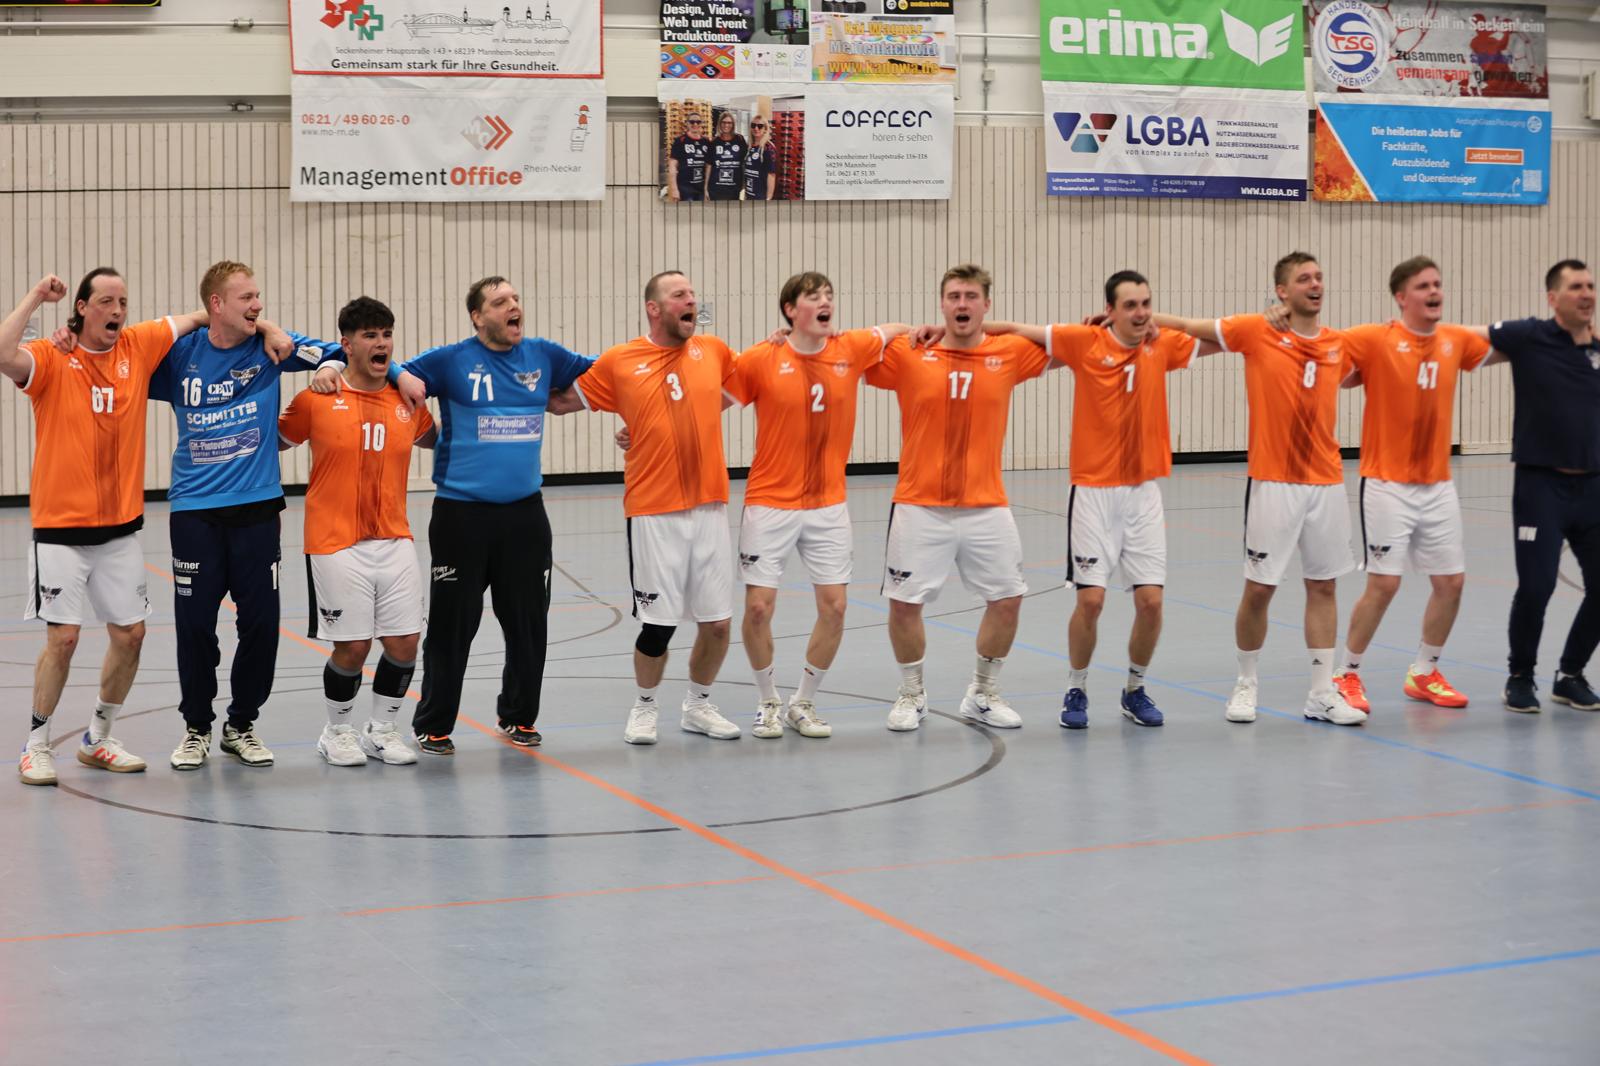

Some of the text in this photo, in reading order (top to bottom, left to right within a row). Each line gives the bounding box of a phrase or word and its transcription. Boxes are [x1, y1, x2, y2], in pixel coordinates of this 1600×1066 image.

[663, 4, 743, 16] Design, Video,
[663, 17, 747, 29] Web und Event
[1393, 14, 1545, 32] Handball in Seckenheim
[663, 30, 741, 42] Produktionen.
[1049, 9, 1209, 60] erima
[1330, 33, 1374, 50] TSG
[1396, 50, 1465, 63] zusammen
[331, 58, 559, 71] Gemeinsam stark für Ihre Gesundheit.
[1327, 65, 1380, 87] SECKENHEIM
[1396, 67, 1470, 81] gemeinsam
[906, 133, 933, 142] sehen
[1126, 115, 1210, 146] LGBA
[1371, 127, 1462, 138] Die heißesten Jobs für
[1141, 149, 1171, 157] komplex
[1382, 142, 1428, 153] Fachkräfte,
[523, 164, 581, 173] Rhein-Neckar
[1392, 158, 1450, 168] Auszubildende
[1403, 173, 1477, 185] und Quereinsteiger
[1240, 187, 1299, 197] WWW.LGBA.DE
[1303, 360, 1317, 388] 8
[1417, 361, 1439, 389] 47
[182, 377, 202, 407] 16
[468, 372, 494, 401] 71
[666, 372, 684, 401] 3
[948, 371, 973, 400] 17
[91, 385, 114, 413] 67
[811, 383, 825, 412] 2
[362, 422, 385, 452] 10
